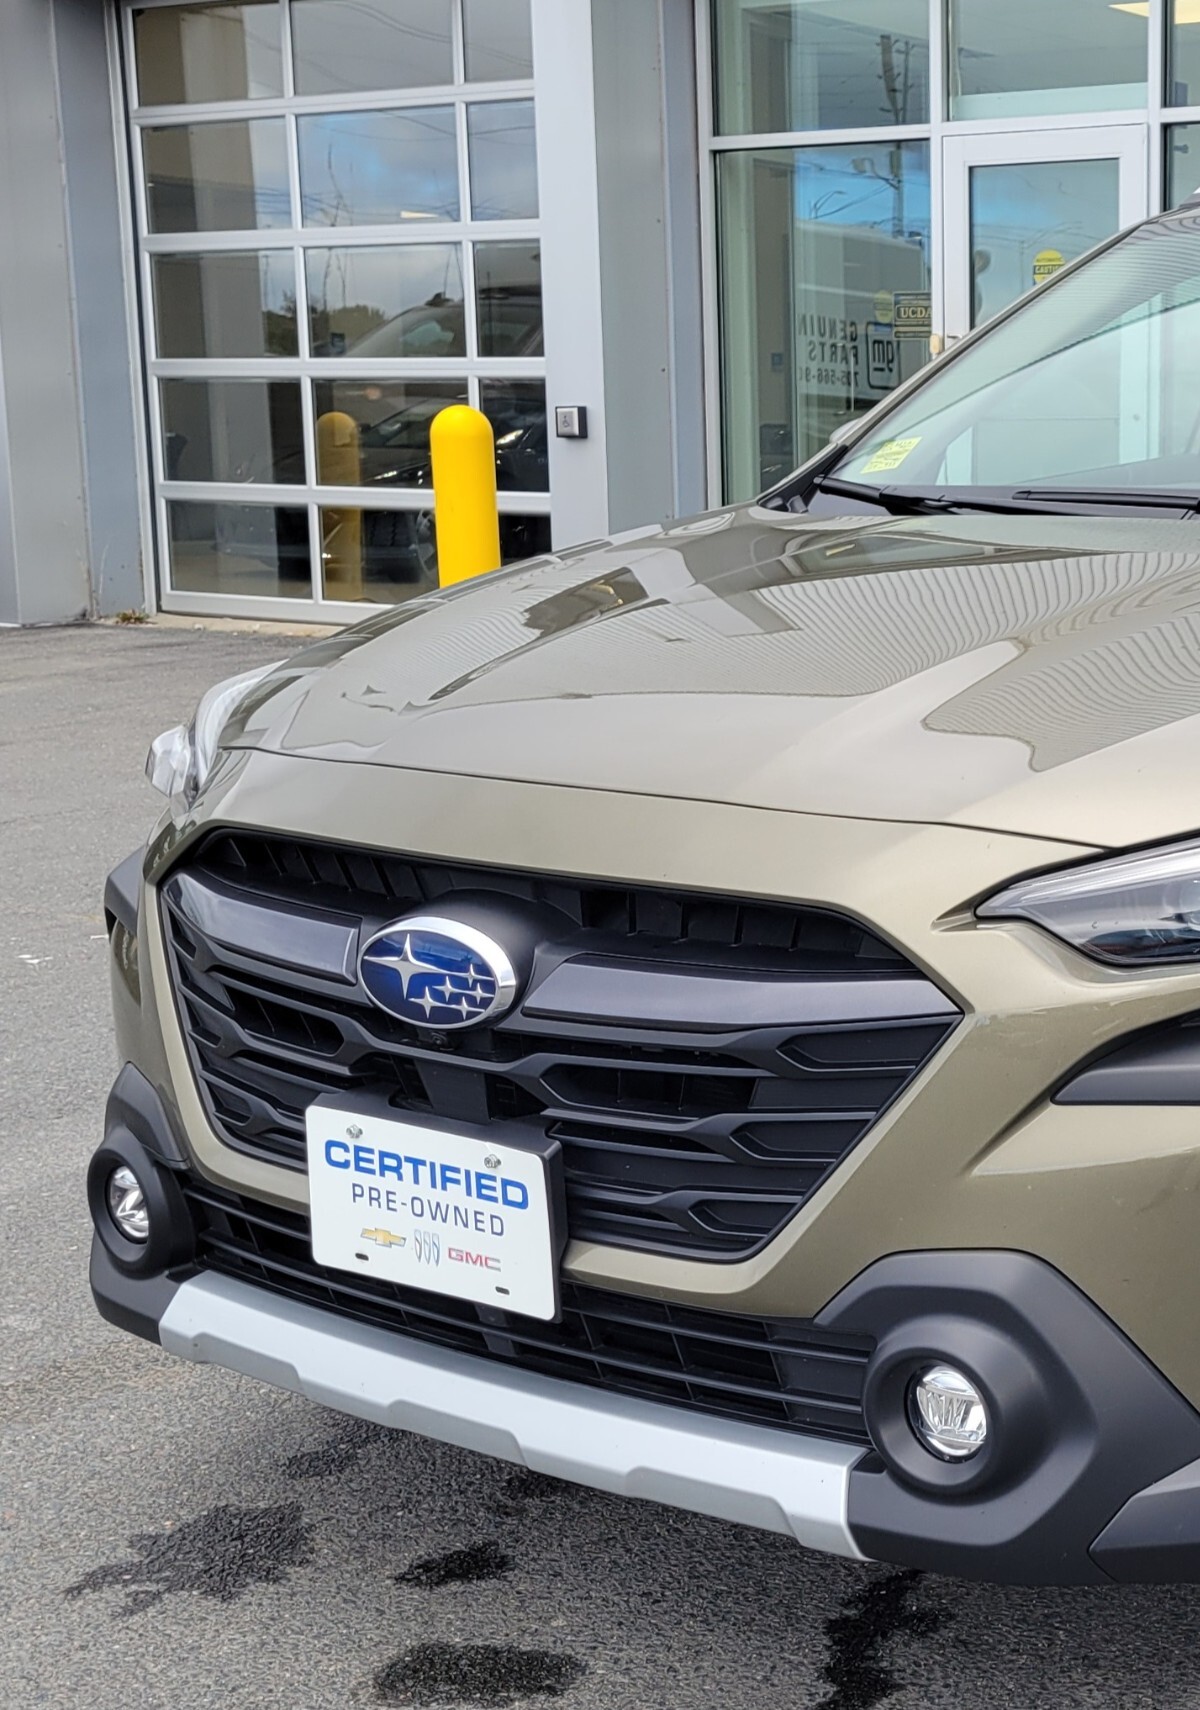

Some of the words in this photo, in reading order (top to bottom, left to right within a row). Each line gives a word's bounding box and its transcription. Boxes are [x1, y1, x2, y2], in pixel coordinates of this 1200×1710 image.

[324, 1139, 529, 1210] CERTIFIED
[352, 1182, 505, 1237] PRE-OWNED
[447, 1246, 502, 1272] GMC
